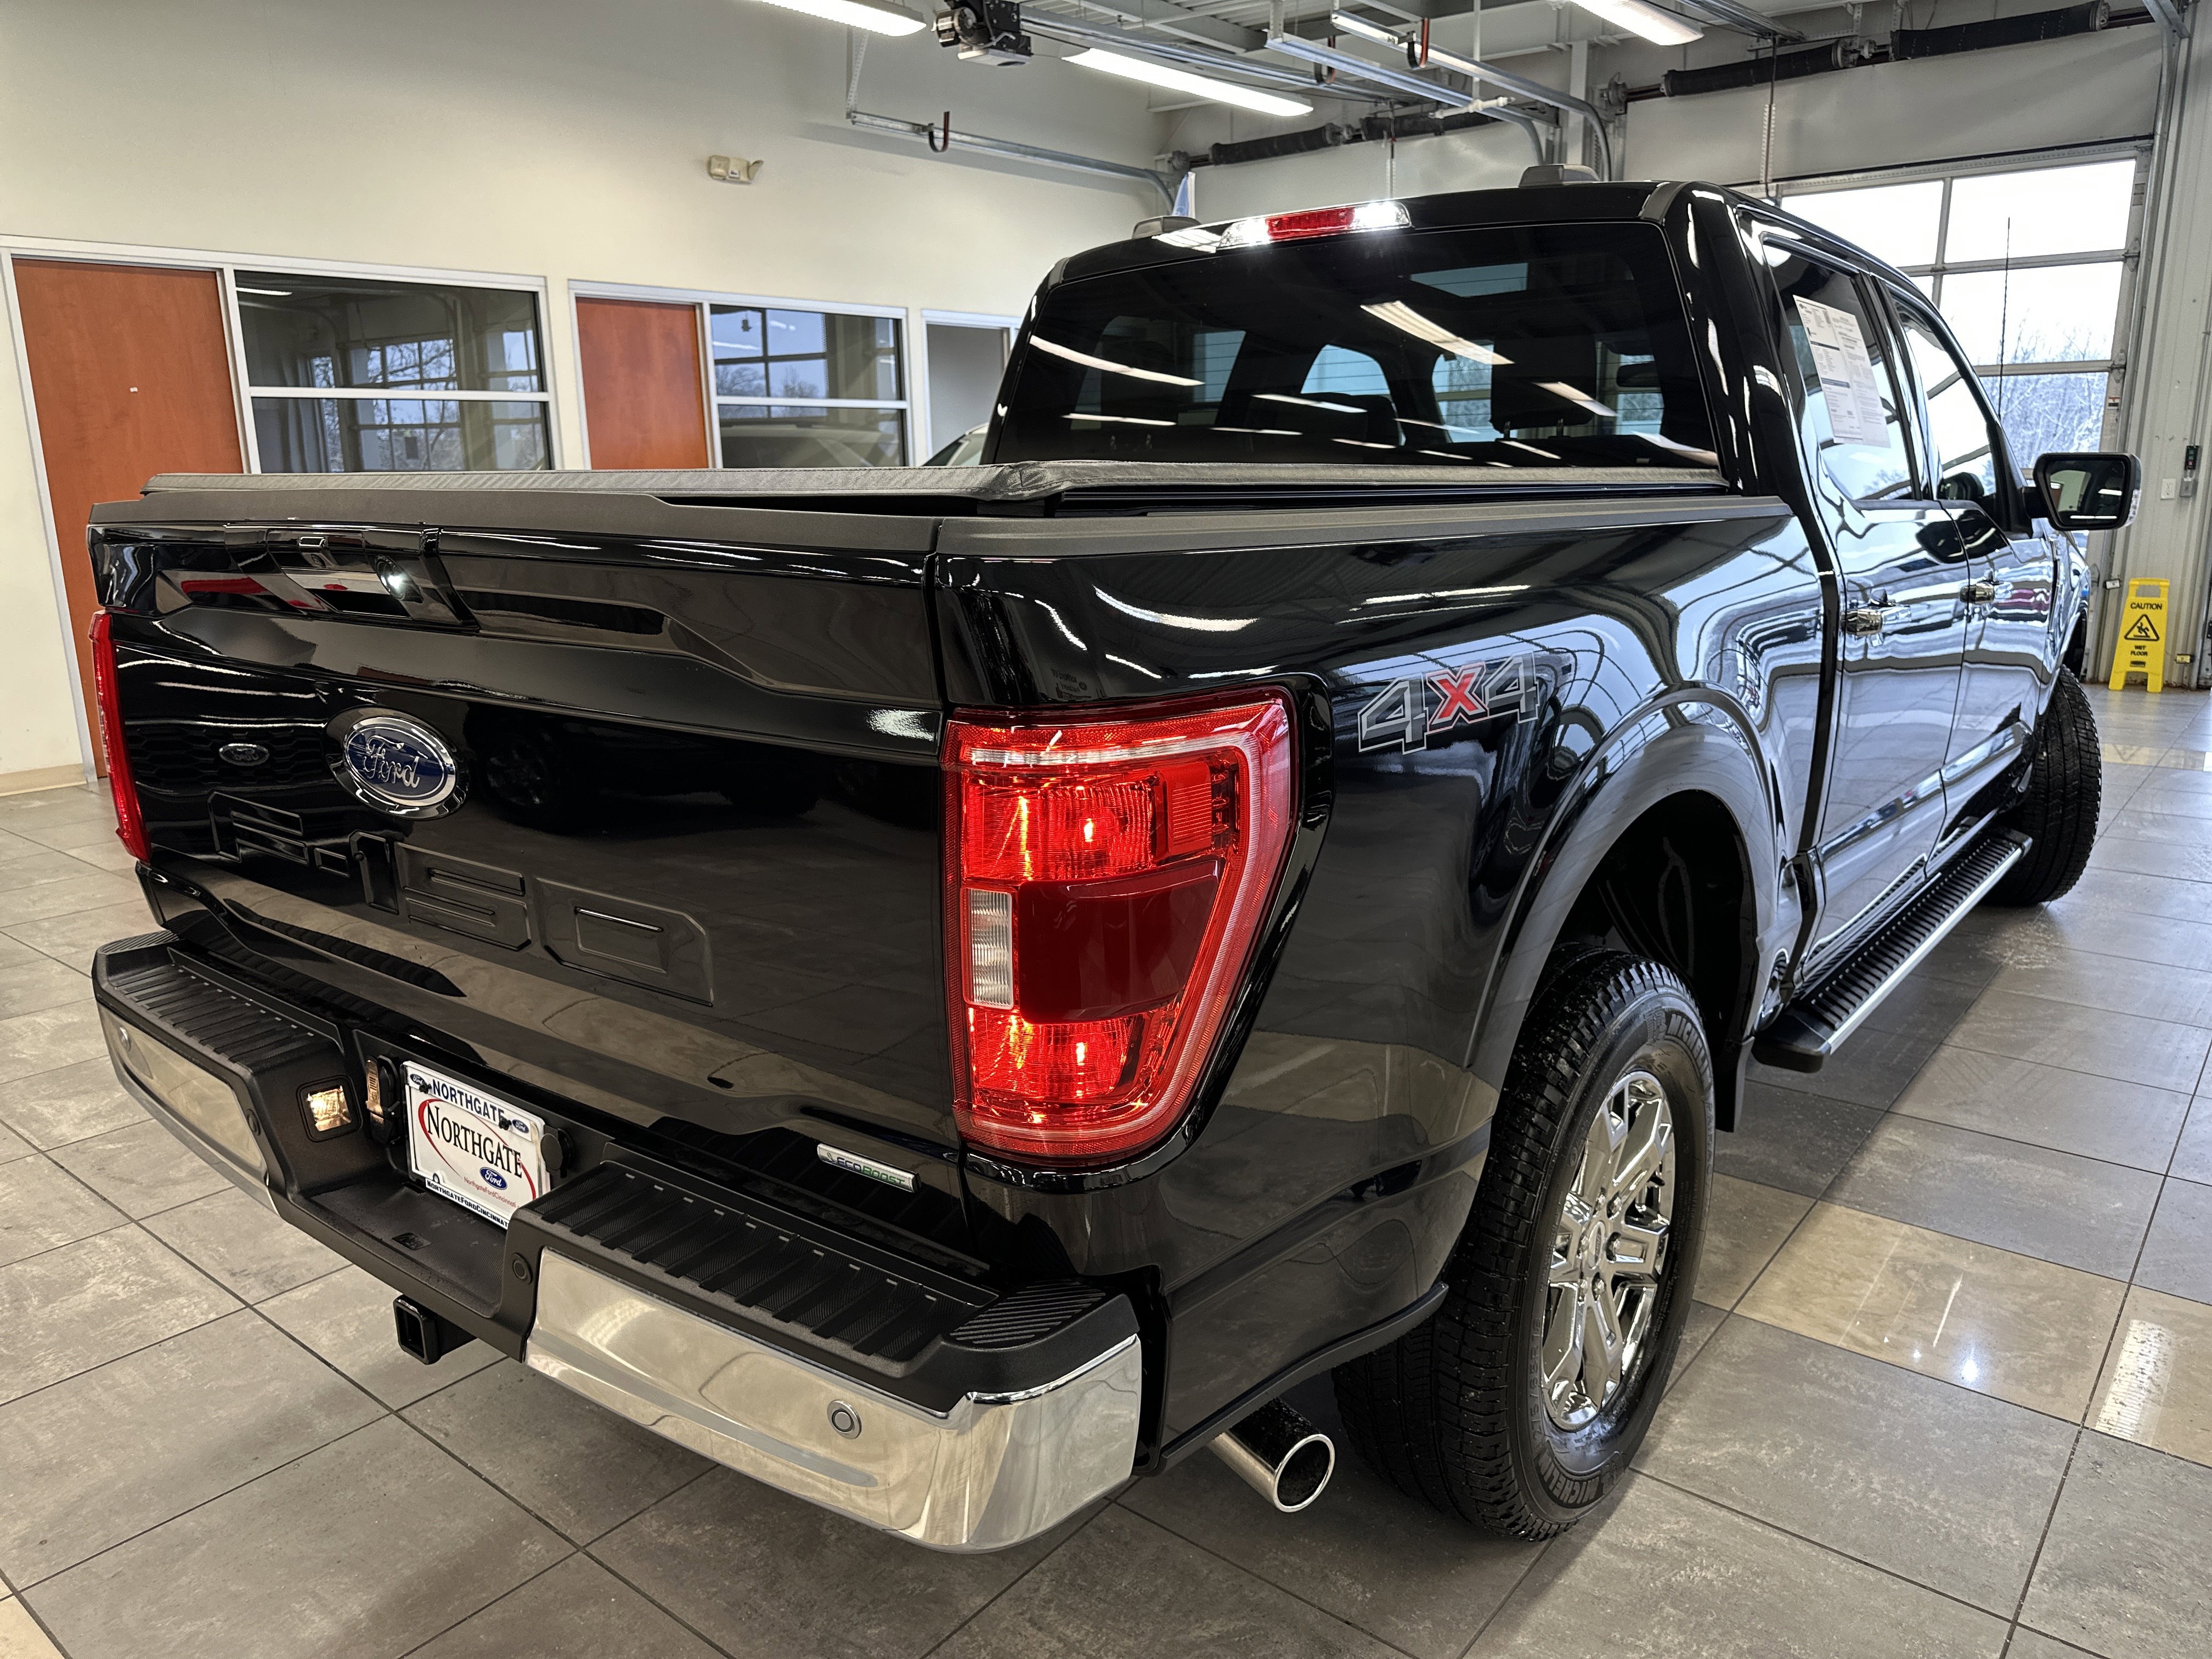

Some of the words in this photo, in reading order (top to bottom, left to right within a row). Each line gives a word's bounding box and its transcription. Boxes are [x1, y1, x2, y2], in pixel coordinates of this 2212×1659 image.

[363, 735, 421, 788] Ford
[1667, 1013, 1712, 1090] MICHELIN
[432, 1079, 504, 1122] NORTHGATE
[426, 1101, 522, 1178] NORTHGATE
[484, 1169, 502, 1187] Ford
[837, 1156, 905, 1185] ECOBOOST
[1538, 1451, 1600, 1504] MICHELIN
